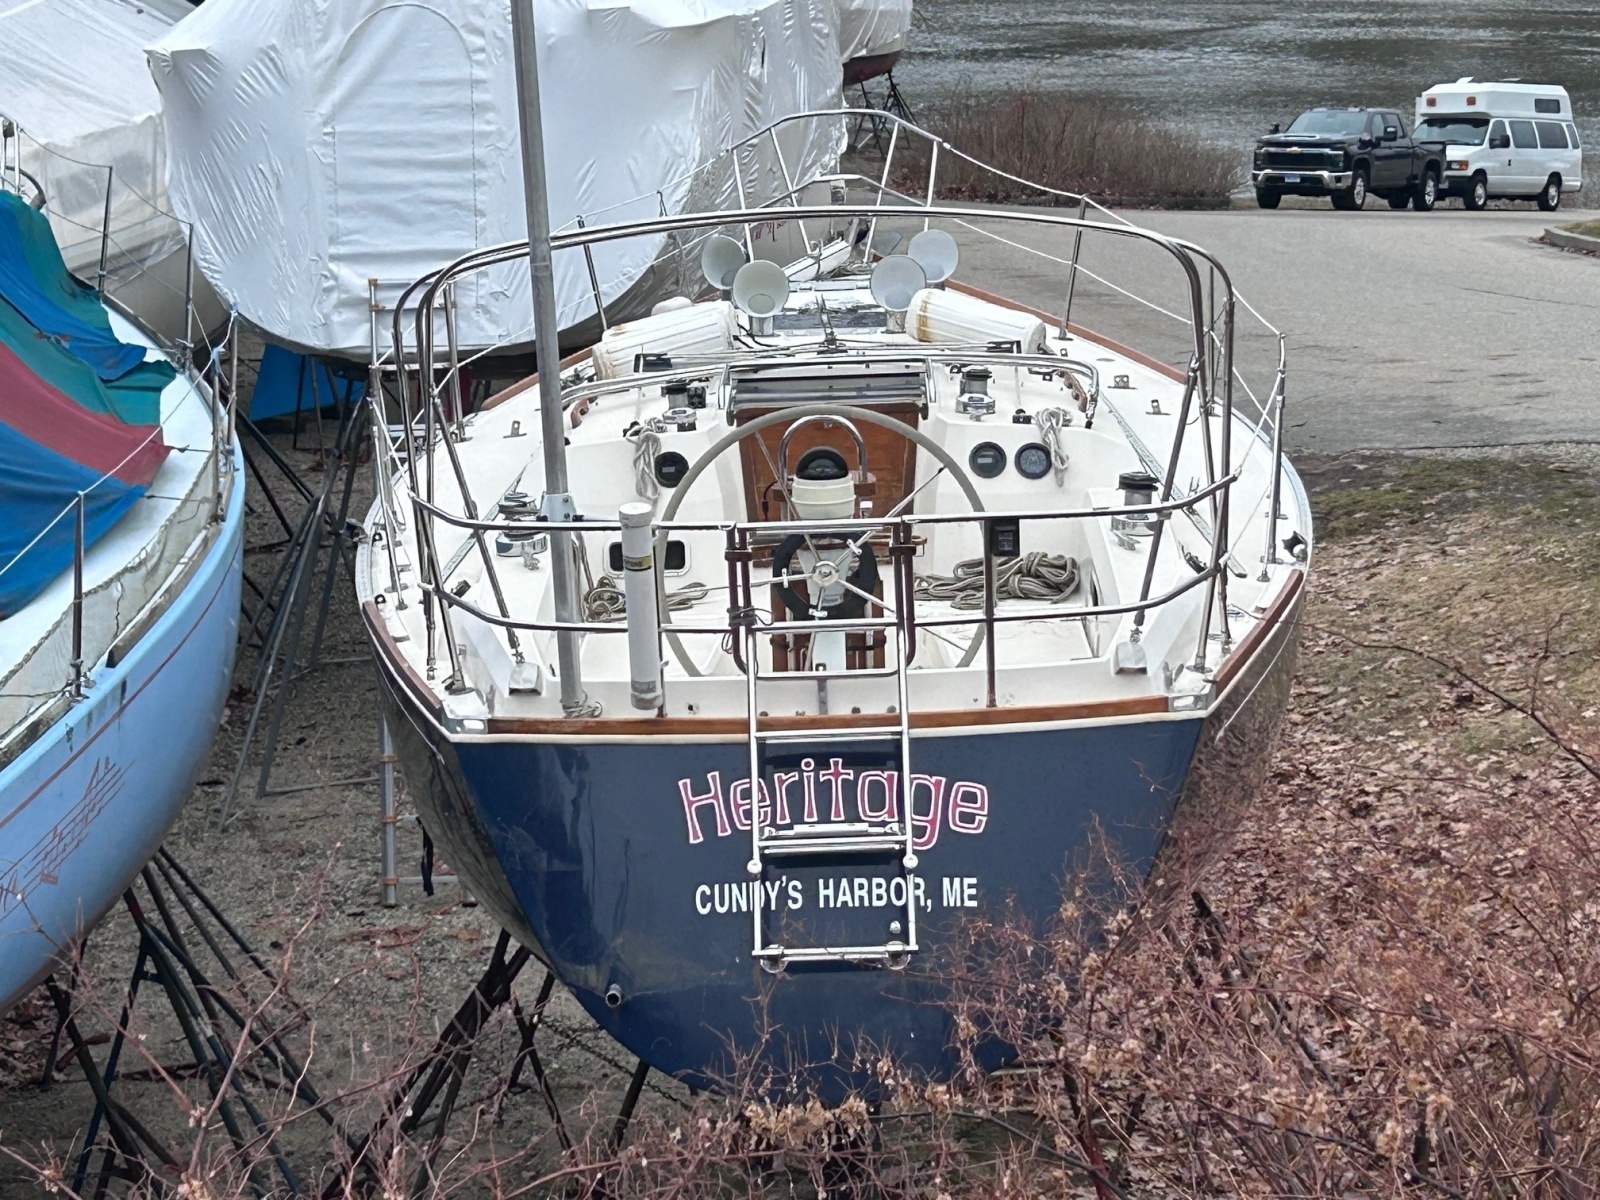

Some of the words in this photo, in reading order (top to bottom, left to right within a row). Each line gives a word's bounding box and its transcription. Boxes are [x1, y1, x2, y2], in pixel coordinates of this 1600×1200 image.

[678, 758, 989, 850] Heritage
[818, 877, 932, 913] HARBOR,
[942, 877, 978, 907] ME
